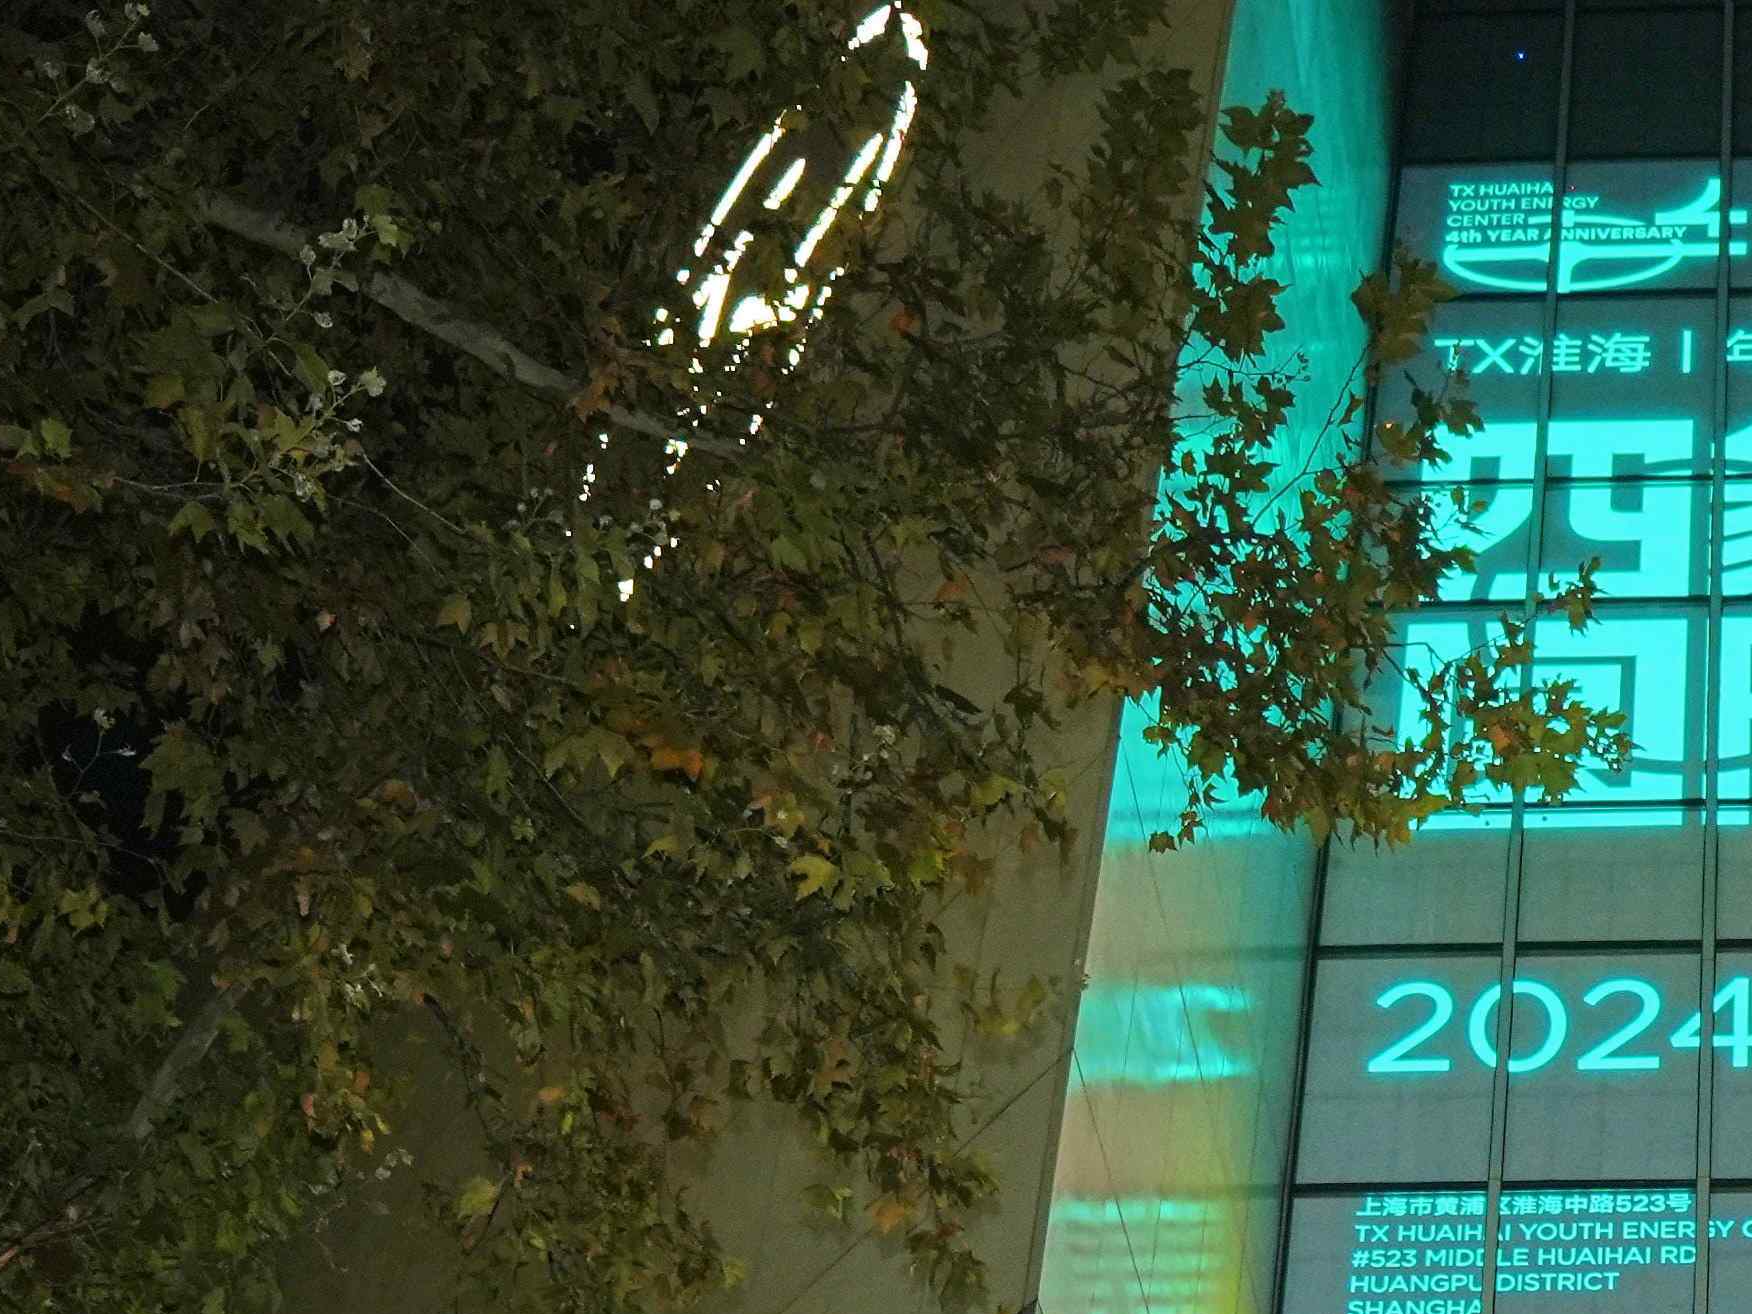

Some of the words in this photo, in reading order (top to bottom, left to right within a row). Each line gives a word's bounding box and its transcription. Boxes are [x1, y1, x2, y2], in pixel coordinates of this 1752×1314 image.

[1479, 182, 1554, 197] HUAIHA
[1449, 199, 1518, 212] YOUTH
[1447, 212, 1526, 227] CENTER
[1446, 230, 1483, 244] 4th
[1487, 228, 1539, 242] YEAR
[1543, 226, 1687, 241] NNIVERSARY
[1355, 1224, 1388, 1243] TX
[1520, 1221, 1614, 1241] YOUTH
[1352, 1248, 1417, 1269] #523
[1661, 1245, 1697, 1264] RD
[1497, 1271, 1620, 1292] DISTRICT
